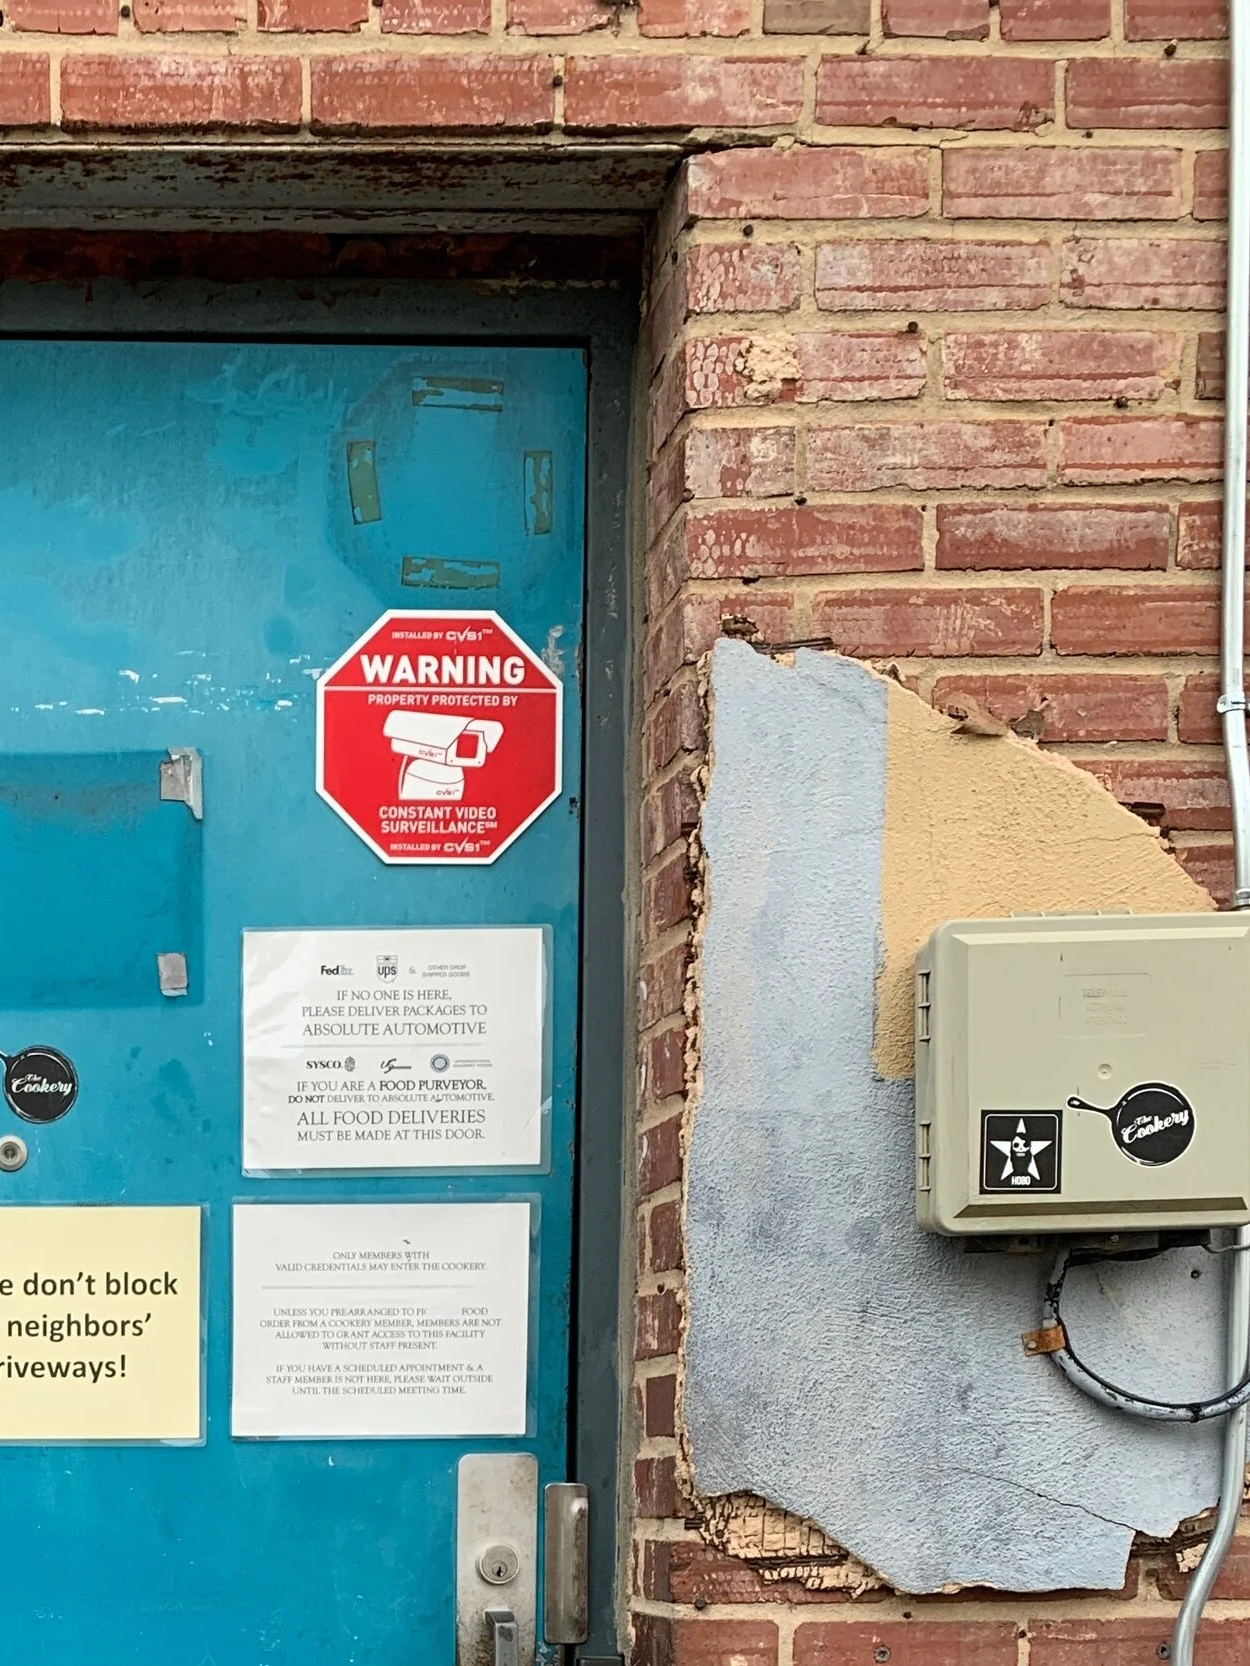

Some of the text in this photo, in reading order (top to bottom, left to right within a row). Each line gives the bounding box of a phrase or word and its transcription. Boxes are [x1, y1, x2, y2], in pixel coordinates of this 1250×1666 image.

[433, 631, 443, 639] BY
[360, 655, 525, 685] WARNING
[368, 694, 518, 707] PROPERTY PROTECTED BY
[379, 806, 496, 819] CONSTANT VIDEO
[431, 843, 441, 851] BY
[378, 965, 396, 978] ups
[337, 990, 451, 1000] IF NO ONE IS HERE,
[302, 1005, 487, 1016] PLEASE DELIVER PACKAGES TO
[303, 1022, 486, 1036] ABSOLUTE AUTOMOTIVE
[25, 1073, 42, 1082] The
[11, 1078, 72, 1096] Cookery
[297, 1081, 308, 1092] IF
[311, 1081, 338, 1091] YOU
[341, 1081, 364, 1091] ARE
[367, 1081, 376, 1091] A
[380, 1080, 415, 1091] FOOD
[288, 1095, 303, 1103] DO
[305, 1095, 325, 1103] NOT
[327, 1095, 365, 1103] DELIVER
[367, 1094, 380, 1102] TO
[381, 1094, 428, 1102] ABSOLUTE
[297, 1109, 485, 1125] ALL FOOD DELIVERIES
[1134, 1115, 1153, 1126] The
[1121, 1109, 1190, 1145] Cookery
[298, 1131, 334, 1141] MUST
[337, 1130, 351, 1140] BE
[355, 1130, 391, 1140] MADE
[394, 1130, 410, 1140] AT
[413, 1129, 441, 1140] THIS
[1011, 1176, 1031, 1185] HOBO
[333, 1252, 356, 1260] ONLY
[405, 1251, 429, 1260] WITH
[275, 1263, 303, 1271] VALID
[304, 1263, 367, 1271] CREDENTIALS
[369, 1263, 388, 1271] MAY
[391, 1263, 419, 1271] ENTER
[106, 1272, 178, 1296] block
[274, 1308, 307, 1316] UNLESS
[309, 1308, 328, 1316] YOU
[401, 1308, 414, 1316] TO
[462, 1307, 488, 1315] FOOD
[328, 1319, 372, 1327] COOKERY
[417, 1319, 460, 1327] MEMBERS
[275, 1331, 319, 1339] ALLOWED
[336, 1330, 370, 1338] GRANT
[372, 1330, 405, 1338] ACCESS
[407, 1330, 420, 1338] TO
[422, 1330, 443, 1338] THIS
[446, 1330, 485, 1338] FACILITY
[322, 1342, 368, 1350] WITHOUT
[308, 1364, 332, 1372] HAVE
[343, 1364, 397, 1372] SCHEDULED
[399, 1364, 464, 1372] APPOINTMENT
[266, 1376, 292, 1384] STAFF
[295, 1376, 332, 1384] MEMBER
[335, 1375, 343, 1383] IS
[345, 1375, 365, 1383] NOT
[394, 1375, 425, 1383] PLEASE
[427, 1375, 451, 1383] WAIT
[453, 1375, 493, 1383] OUTSIDE
[292, 1387, 320, 1395] UNTIL
[322, 1387, 340, 1395] THE
[399, 1386, 439, 1394] MEETING
